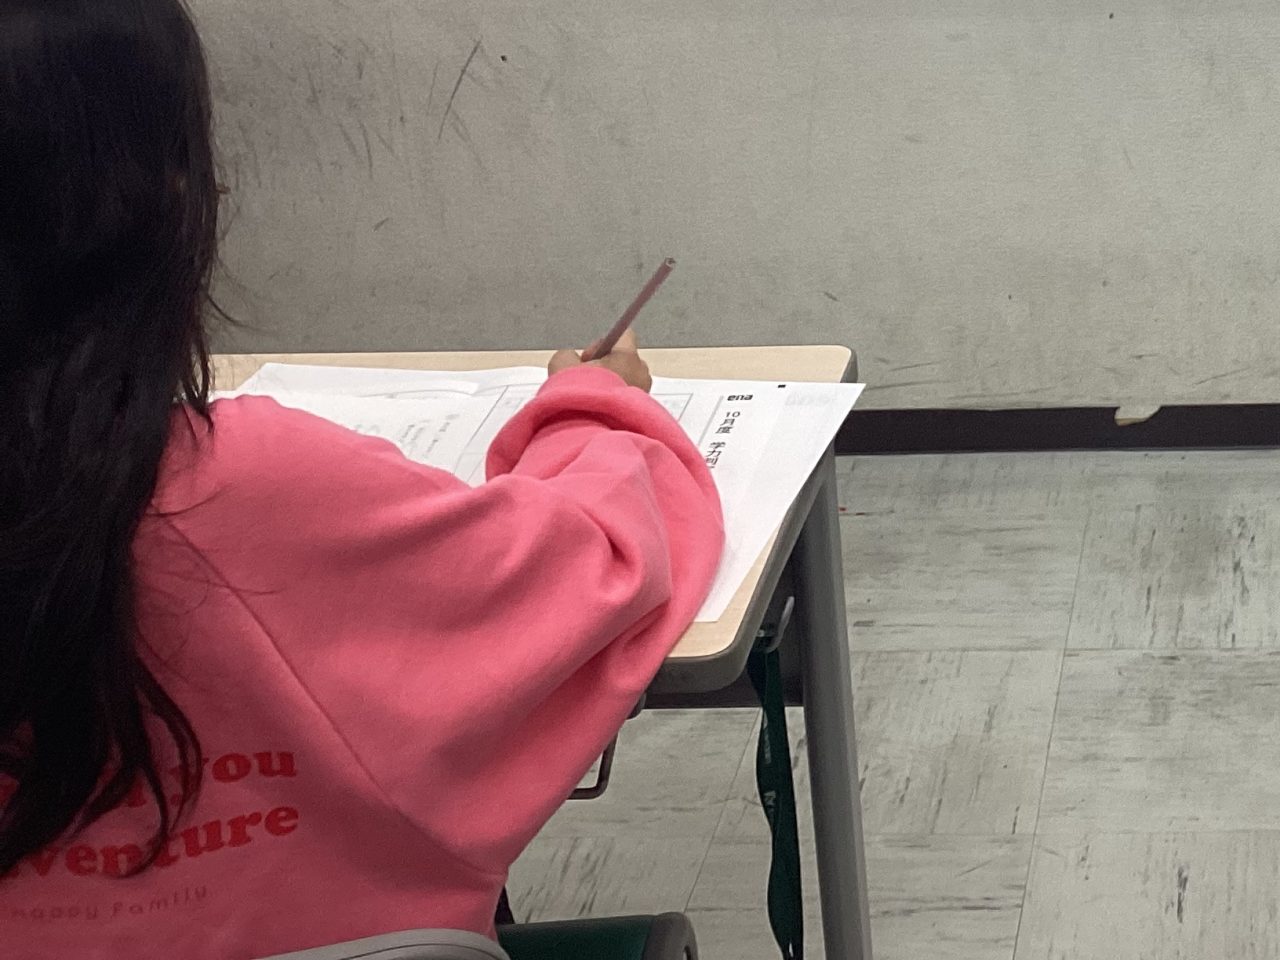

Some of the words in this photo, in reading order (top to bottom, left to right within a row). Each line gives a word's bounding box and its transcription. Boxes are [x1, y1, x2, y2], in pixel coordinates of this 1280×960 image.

[715, 411, 741, 434] 10月度
[705, 441, 726, 469] 学力判
